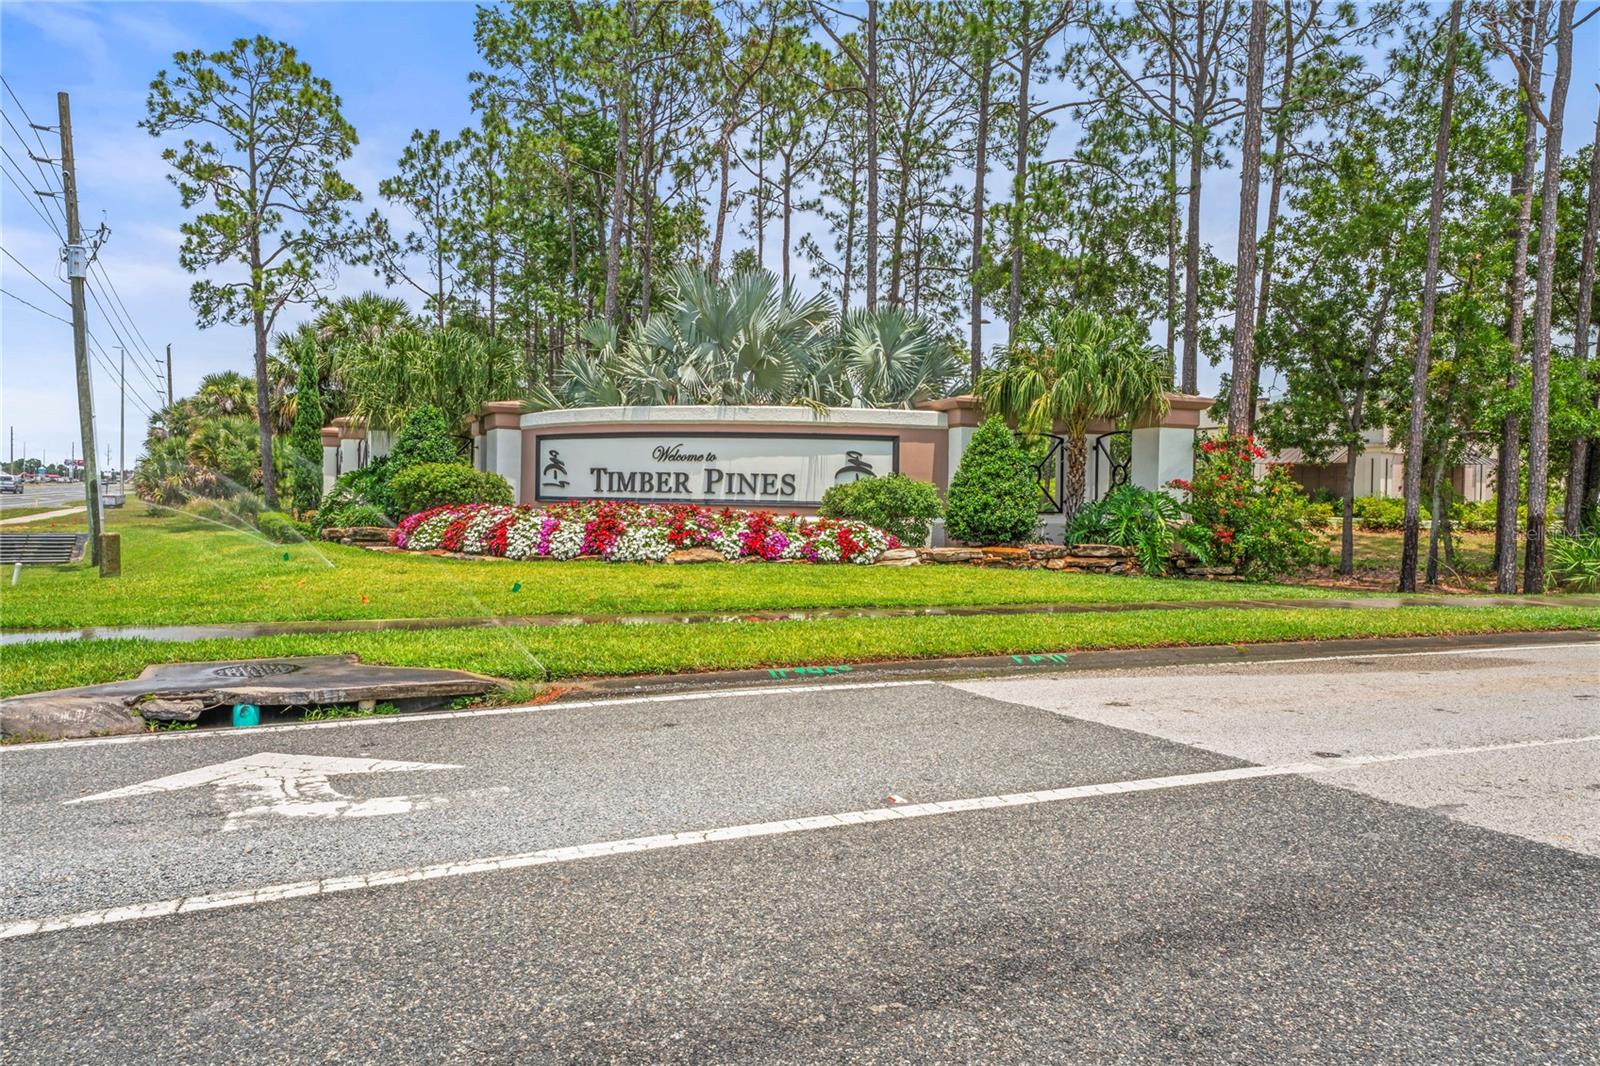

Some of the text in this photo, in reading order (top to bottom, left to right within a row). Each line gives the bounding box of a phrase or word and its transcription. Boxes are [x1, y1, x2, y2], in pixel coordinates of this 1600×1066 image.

[652, 443, 717, 463] Welcome to
[590, 467, 796, 496] TIMBER PINES
